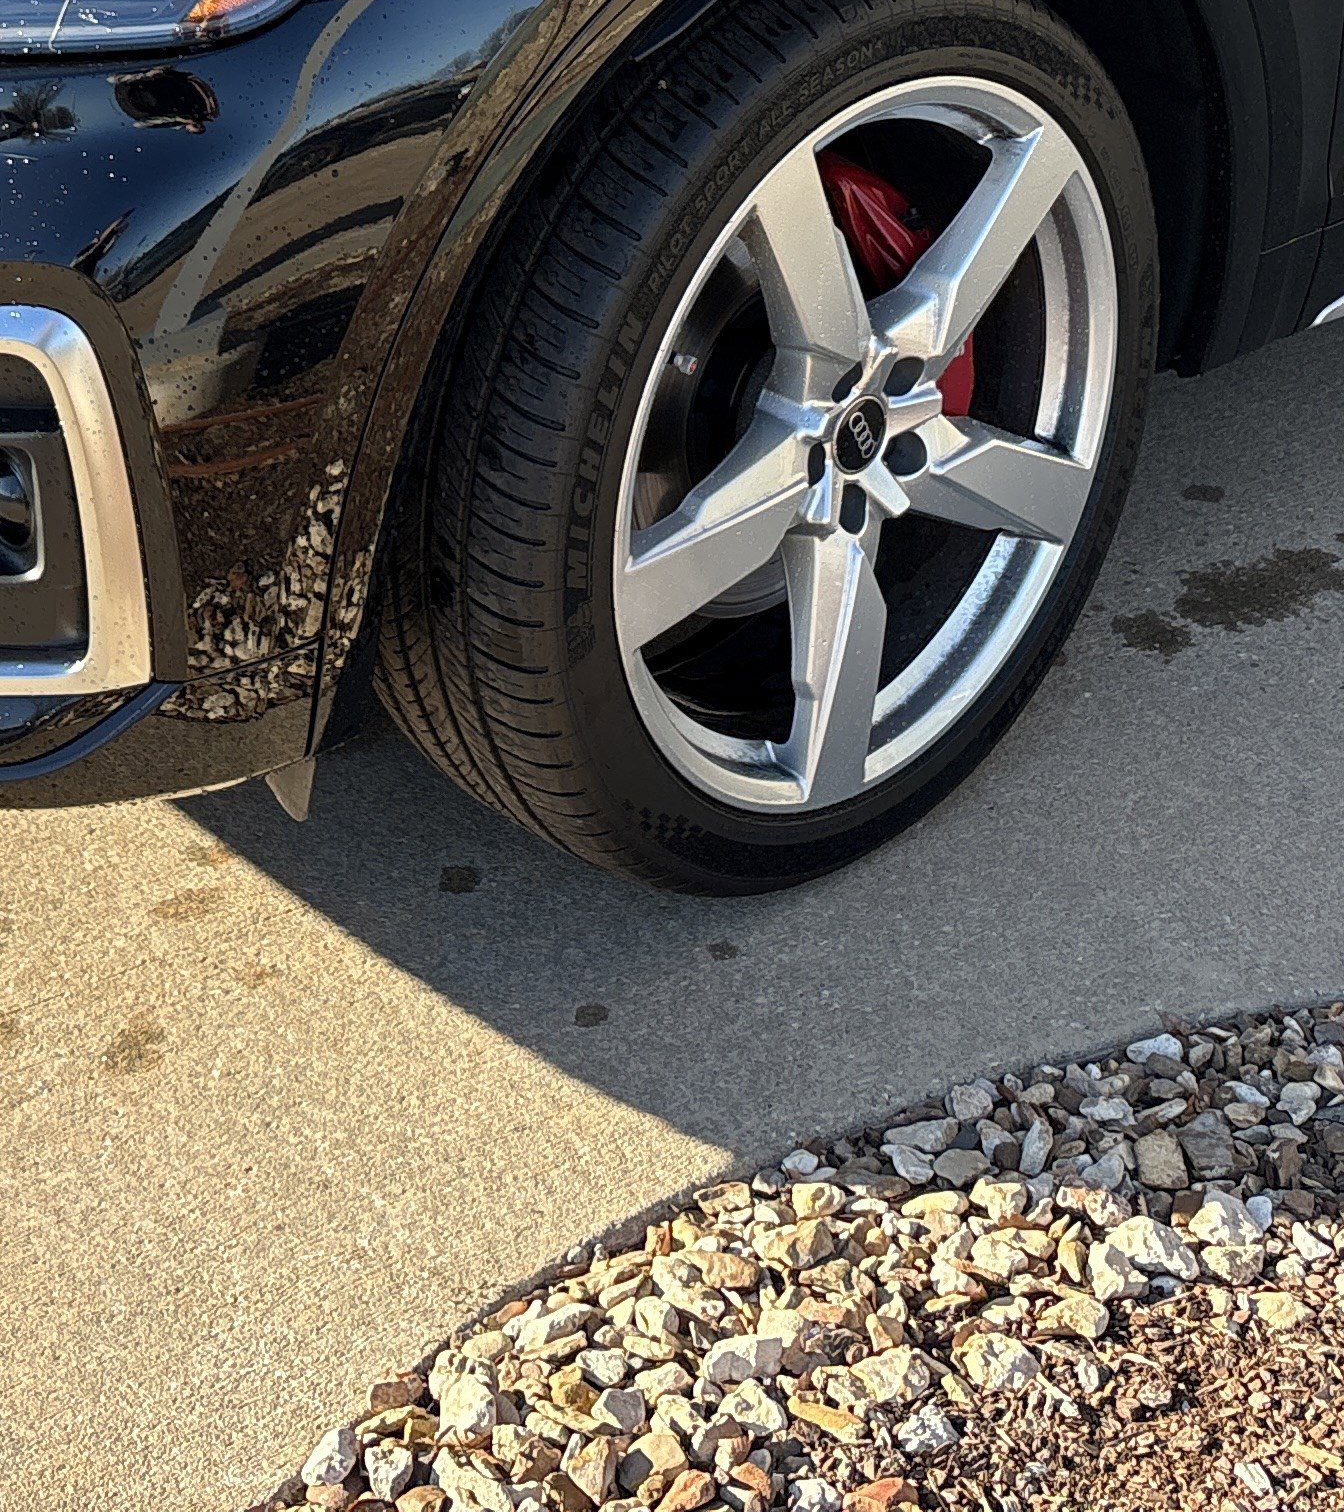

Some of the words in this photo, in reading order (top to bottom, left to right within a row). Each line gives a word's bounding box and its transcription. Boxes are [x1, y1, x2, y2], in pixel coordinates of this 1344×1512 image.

[565, 318, 644, 590] MICHELIN
[650, 219, 691, 296] PILOT
[693, 141, 755, 213] SPORT
[757, 103, 794, 143] ALL
[797, 40, 875, 101] SEASON
